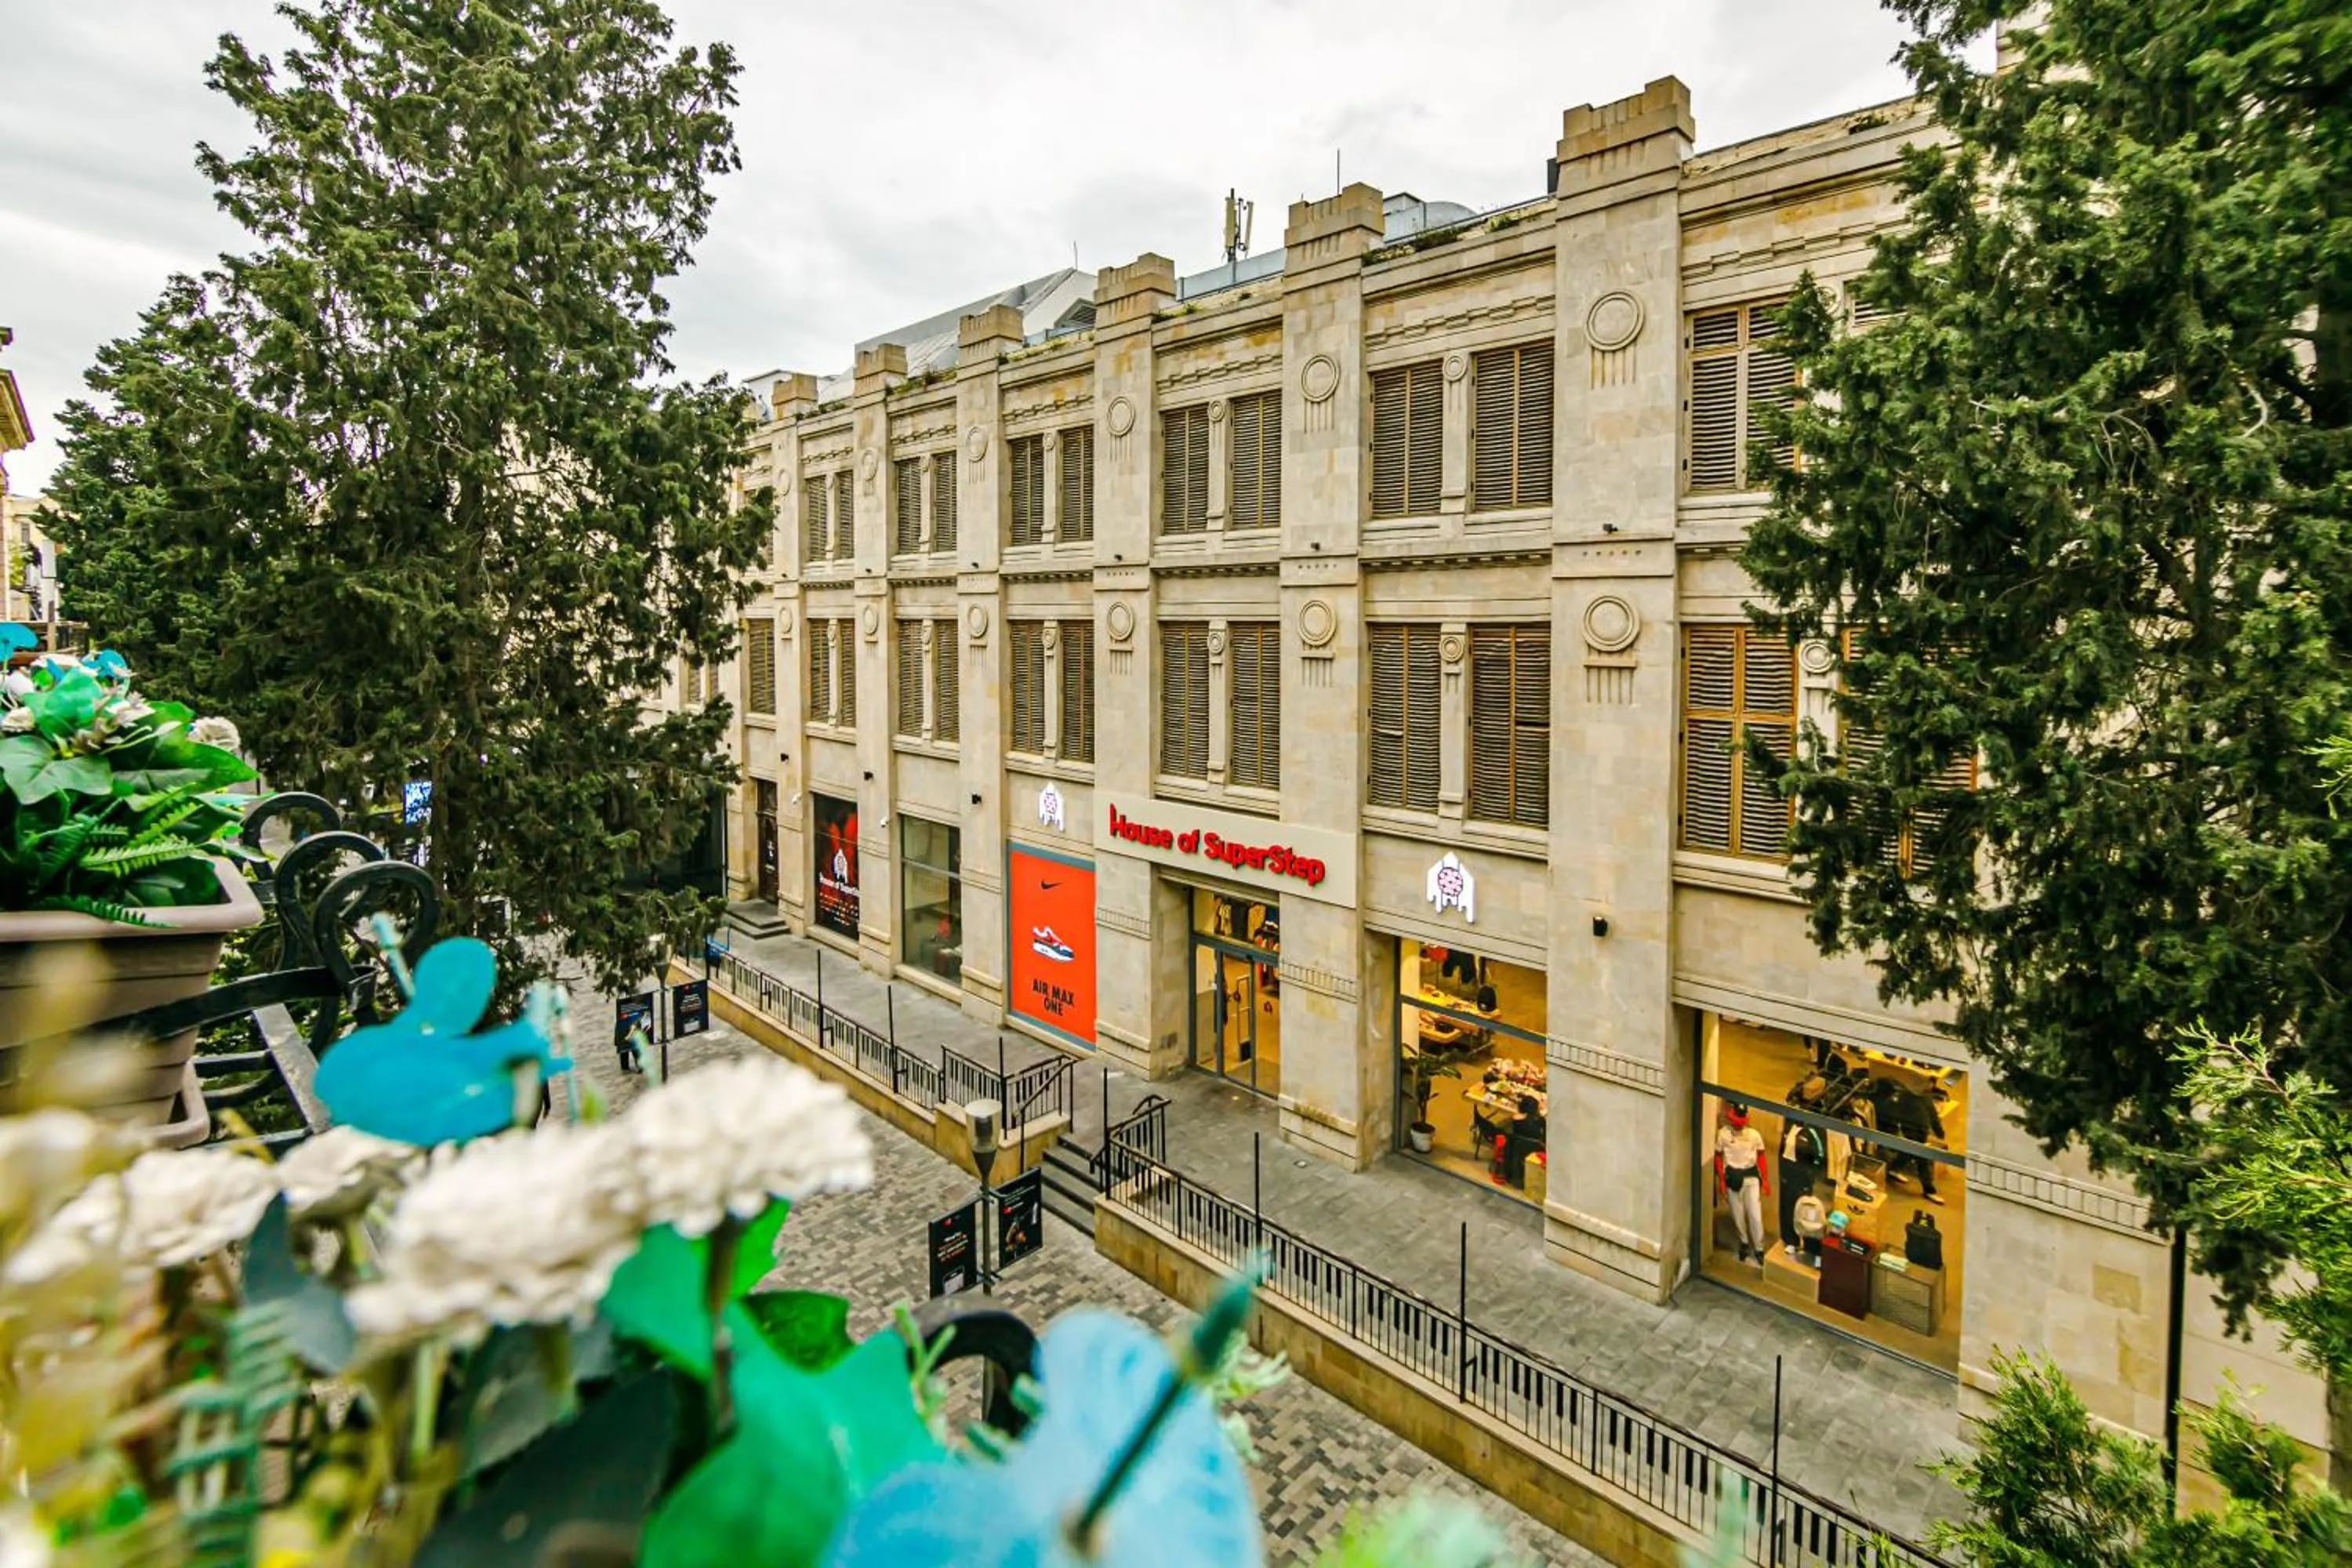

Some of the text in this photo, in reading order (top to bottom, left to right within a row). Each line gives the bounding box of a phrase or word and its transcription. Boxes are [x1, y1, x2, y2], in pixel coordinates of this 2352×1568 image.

[1109, 803, 1326, 887] House of SuperStep
[1033, 978, 1075, 1007] AIR MAX
[1044, 996, 1063, 1017] ONE
